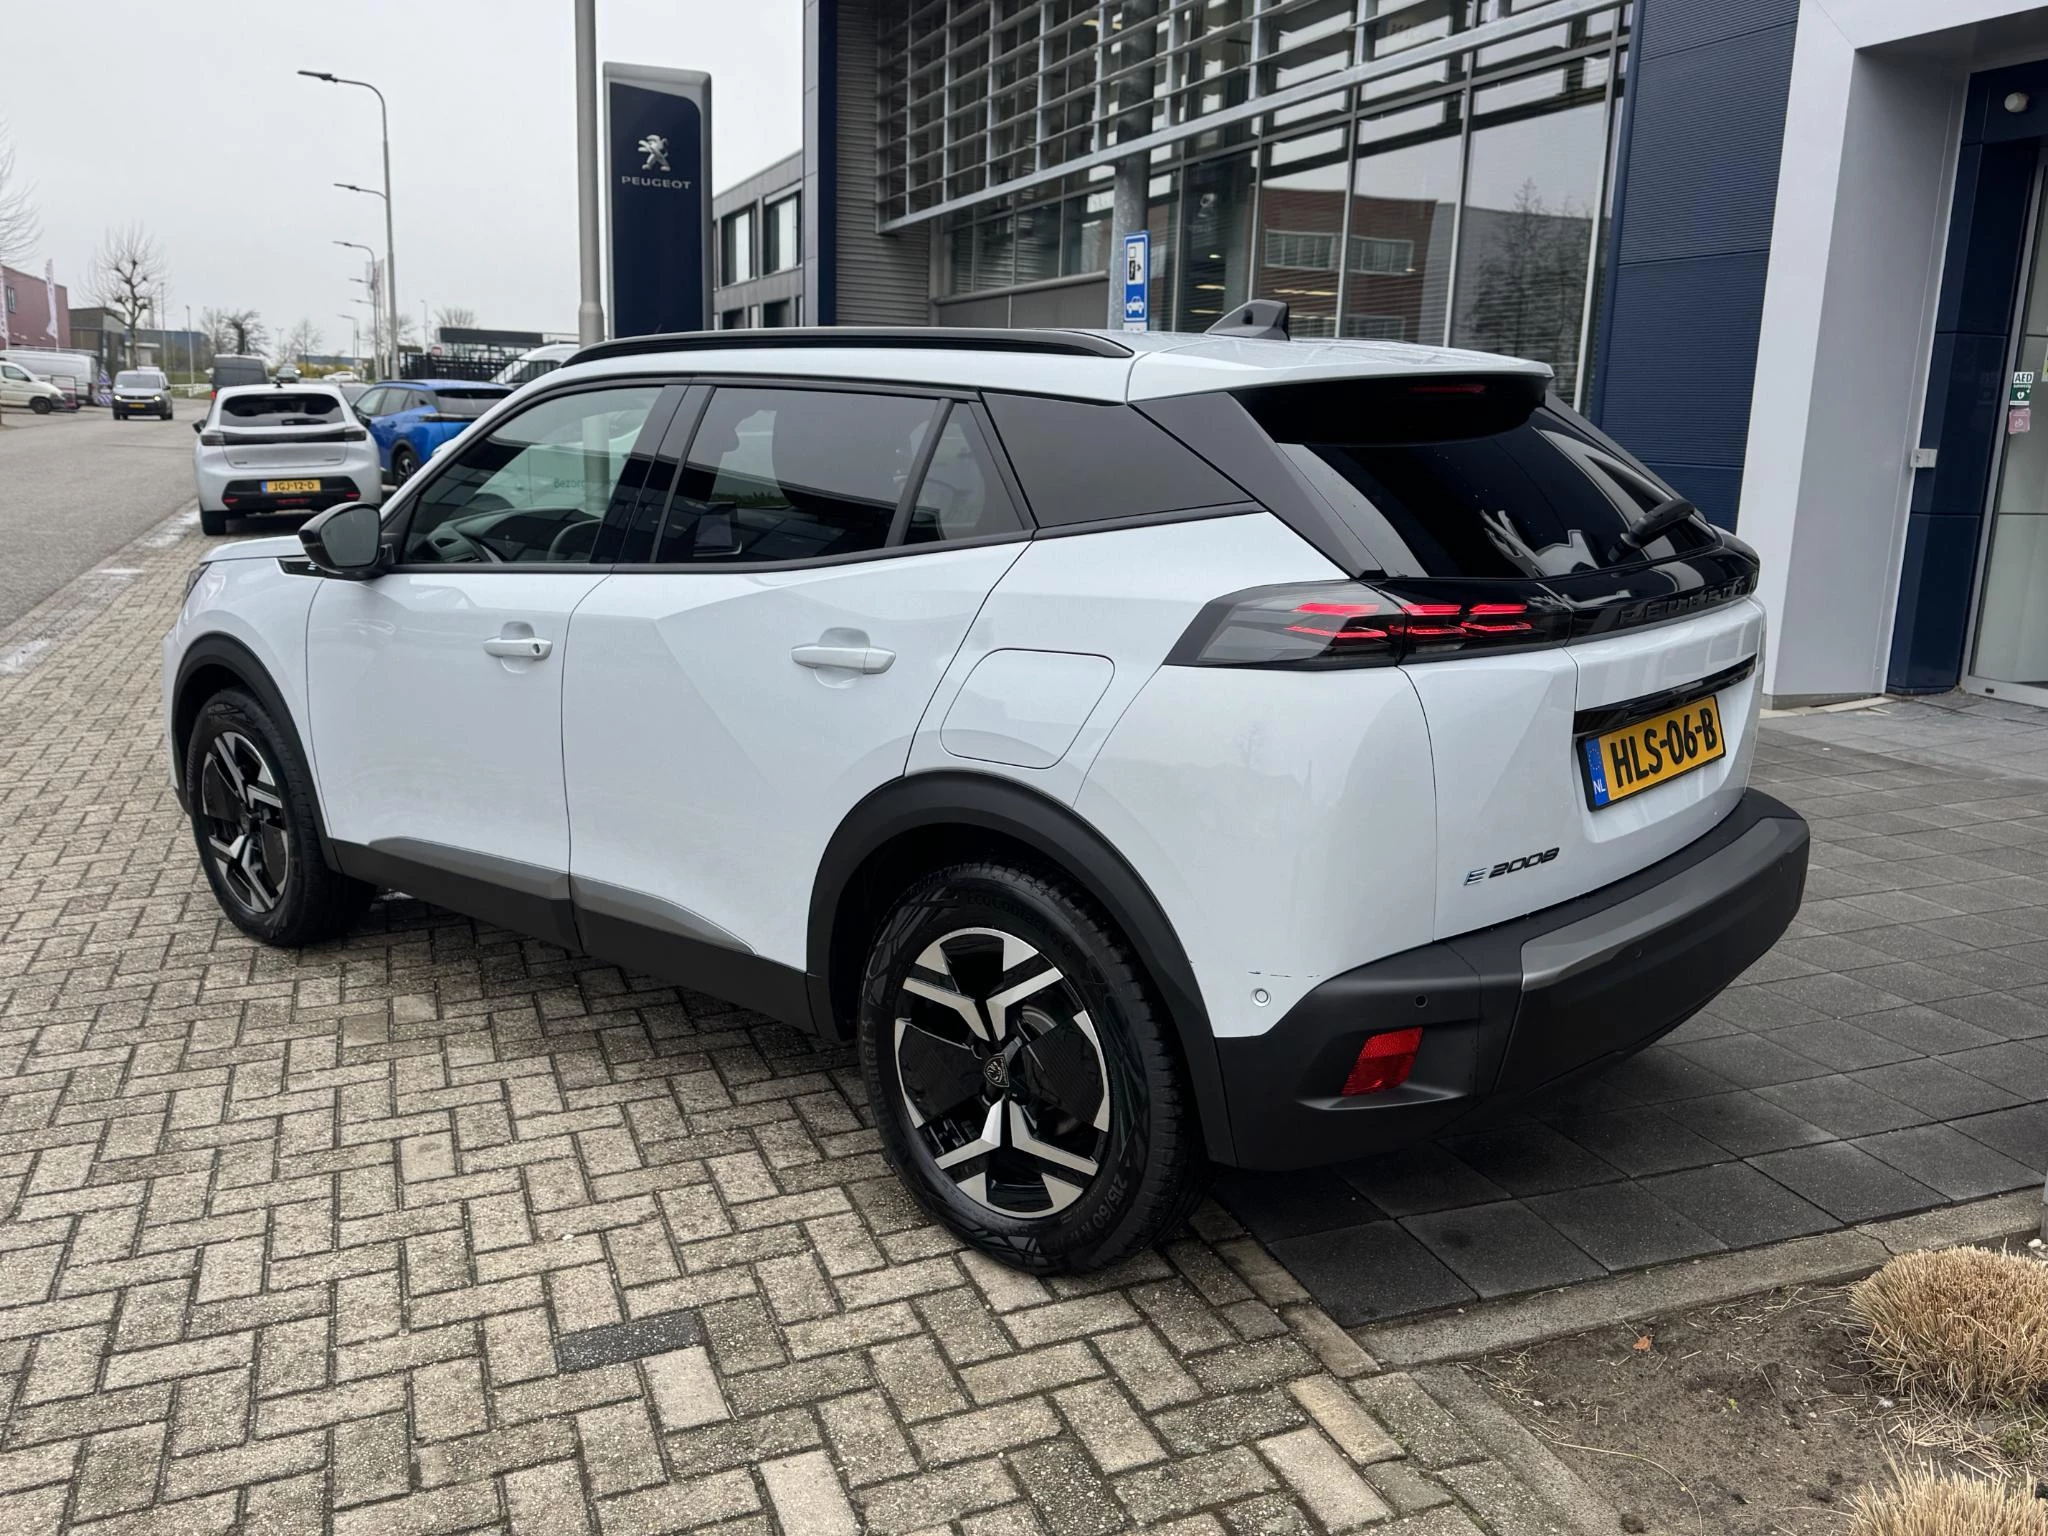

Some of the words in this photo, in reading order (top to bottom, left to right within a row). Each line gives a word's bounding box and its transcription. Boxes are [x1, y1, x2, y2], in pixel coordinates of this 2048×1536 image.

[621, 176, 691, 189] PEUGEOT
[2015, 373, 2033, 382] AED
[1609, 708, 1718, 788] HLS-06-B
[1593, 778, 1606, 795] NL
[1488, 847, 1560, 878] 2008
